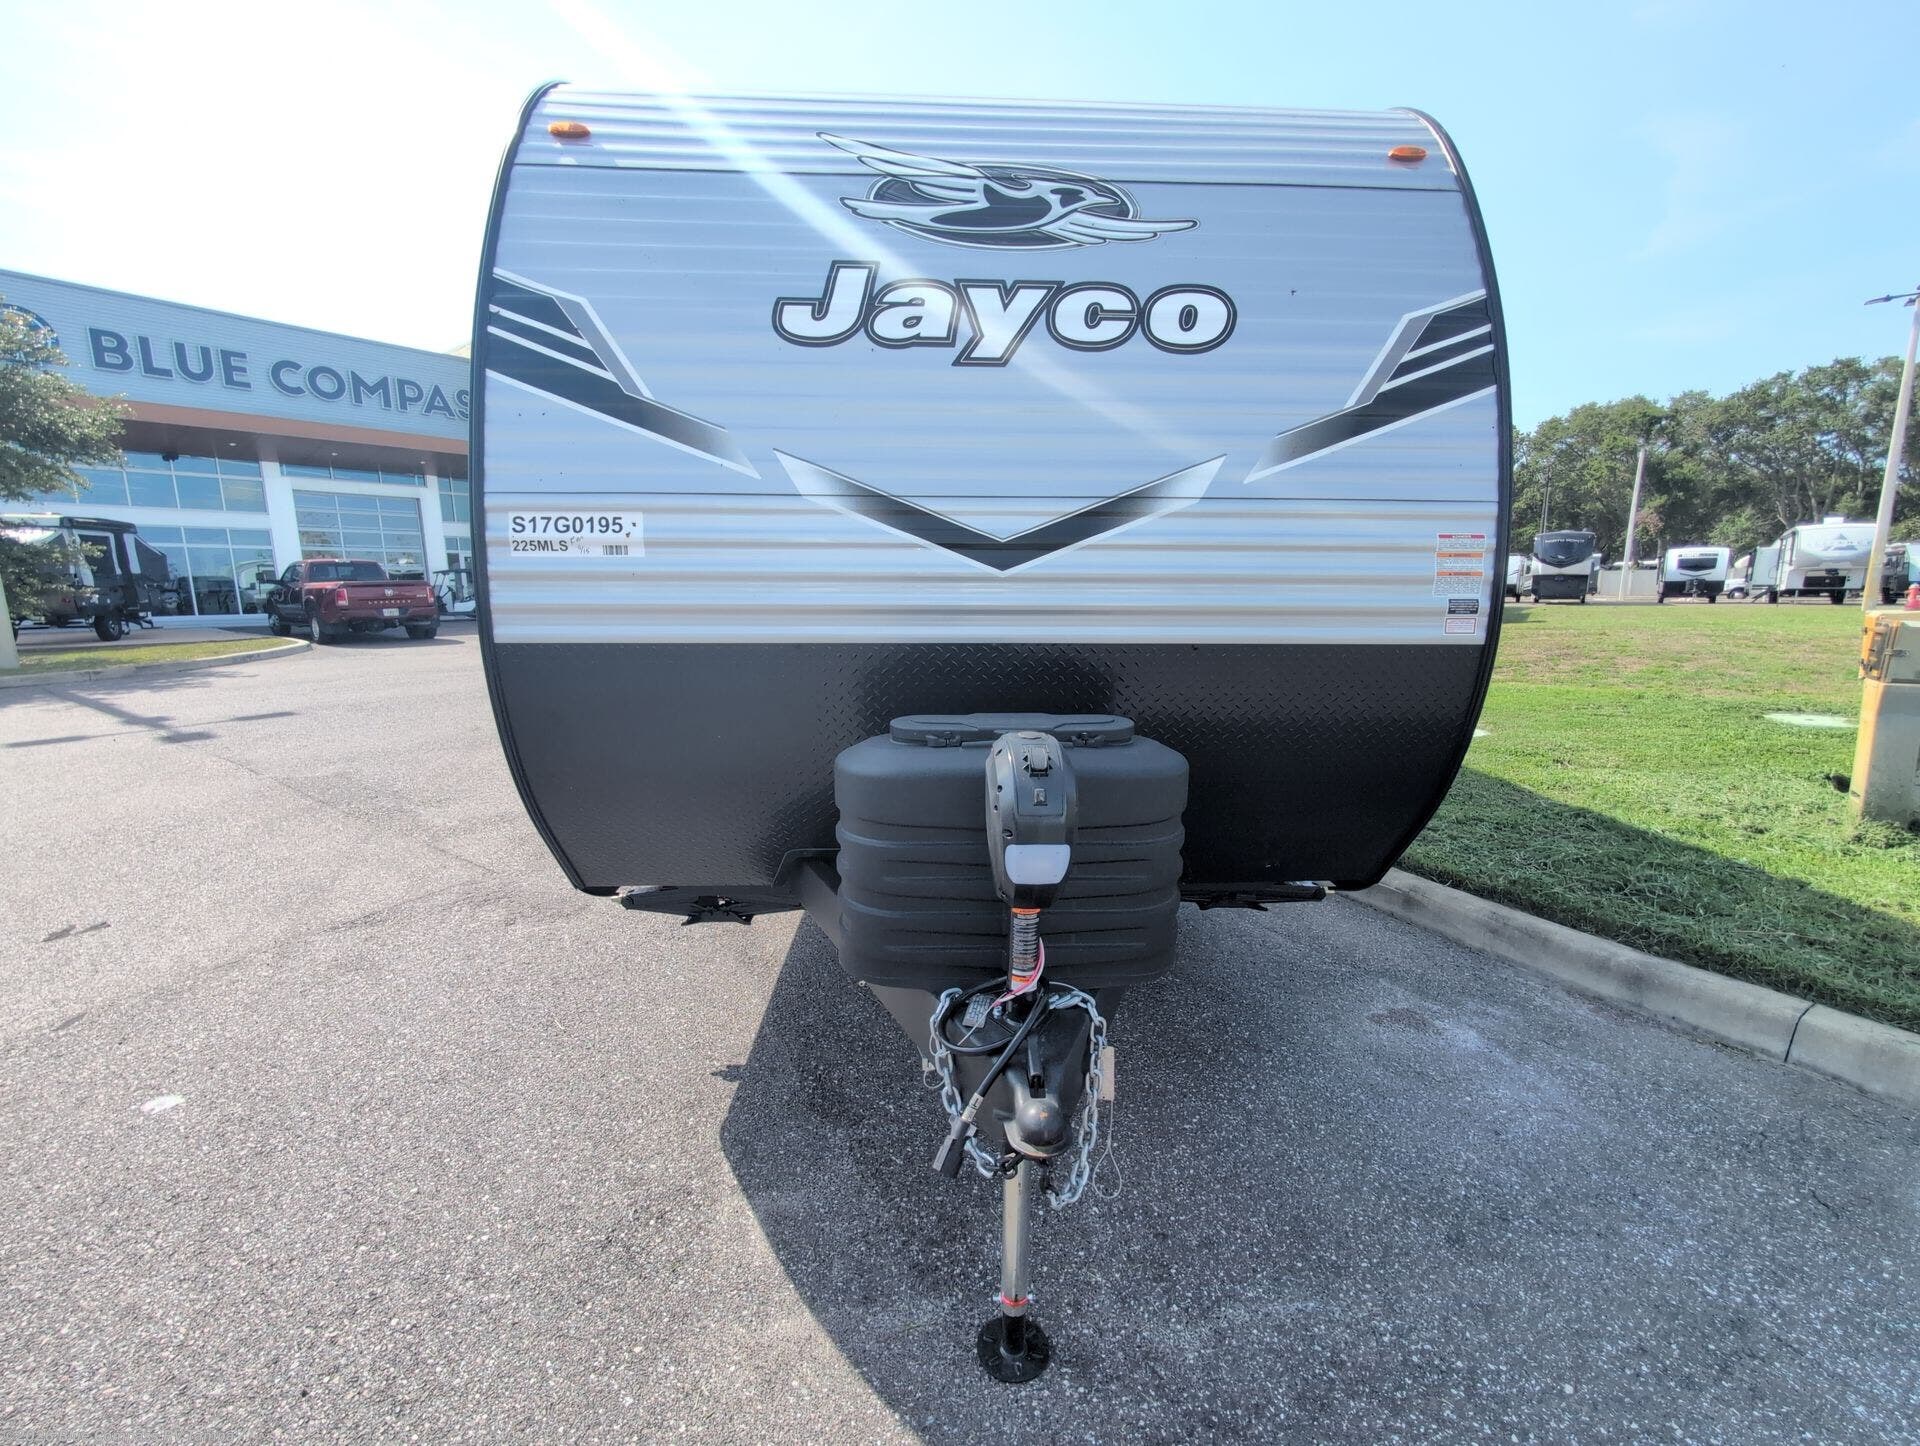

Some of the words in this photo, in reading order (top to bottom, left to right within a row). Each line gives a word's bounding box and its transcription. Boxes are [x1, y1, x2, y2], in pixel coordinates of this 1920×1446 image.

[772, 260, 1238, 367] Jayco
[87, 327, 252, 389] BLUE
[512, 516, 624, 534] S17G0195
[512, 540, 569, 552] 225MLS
